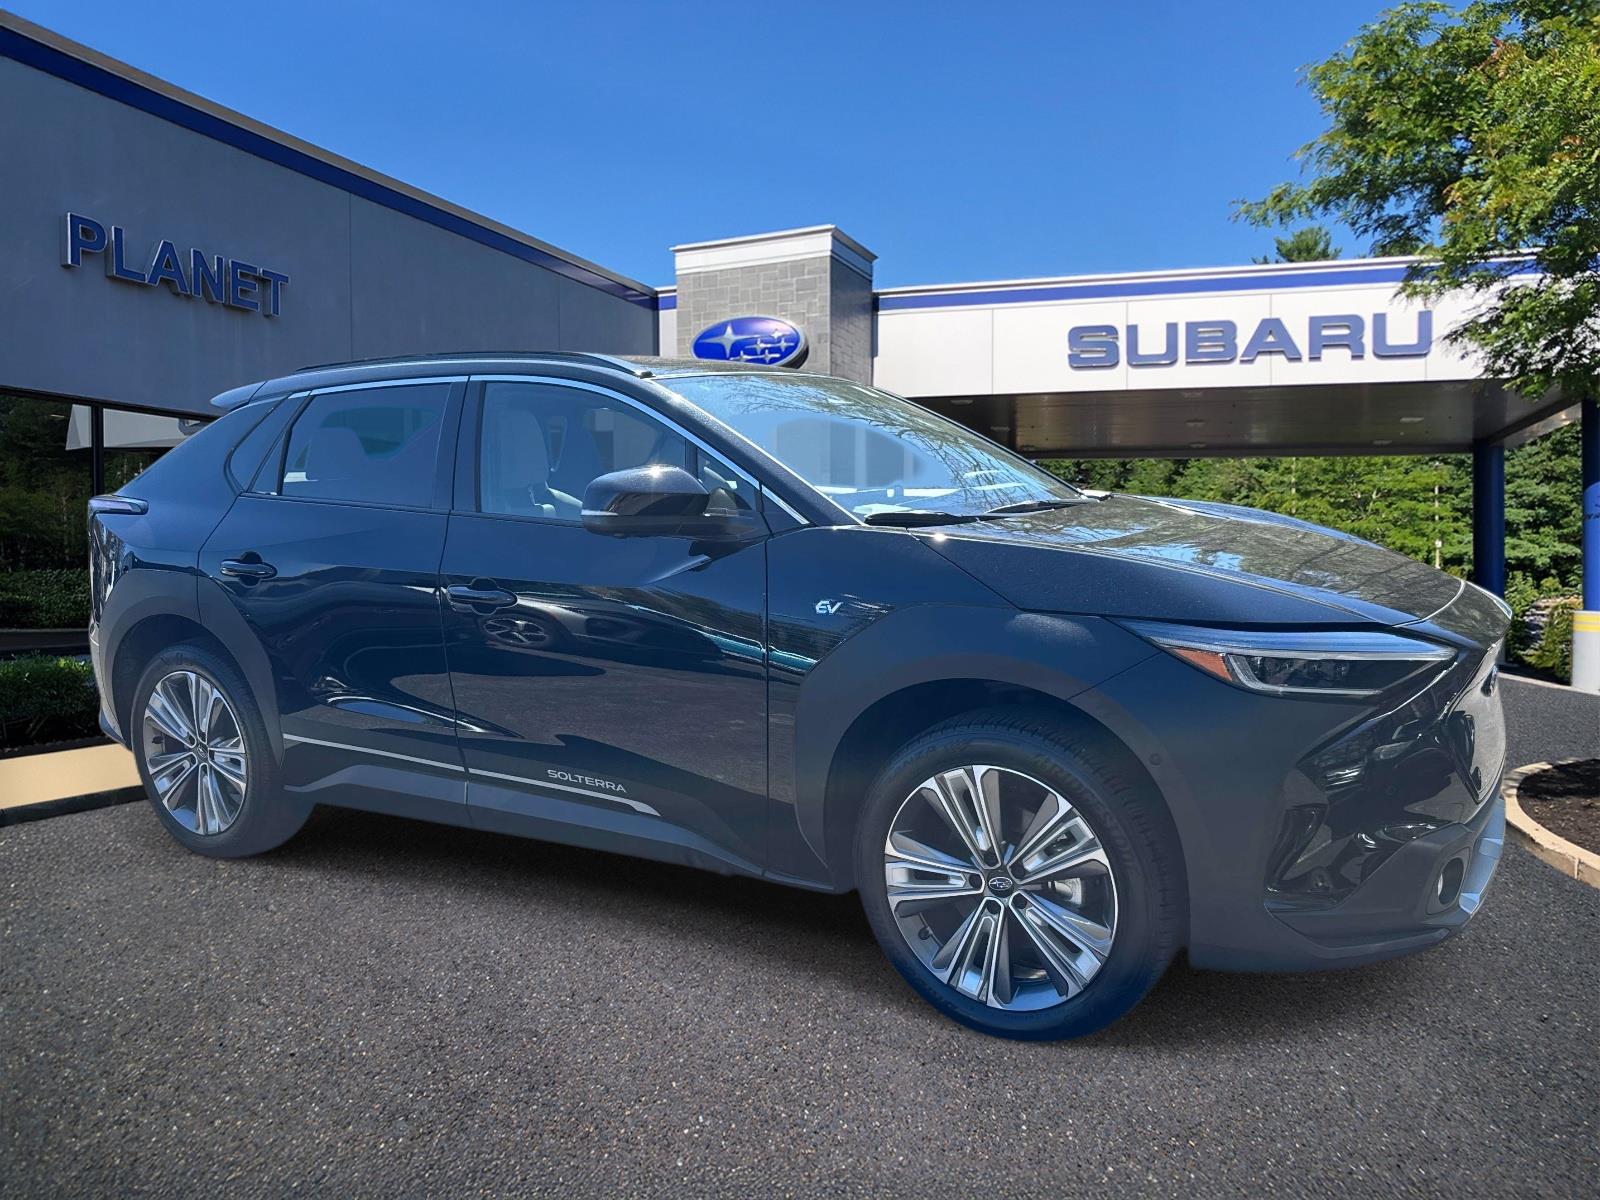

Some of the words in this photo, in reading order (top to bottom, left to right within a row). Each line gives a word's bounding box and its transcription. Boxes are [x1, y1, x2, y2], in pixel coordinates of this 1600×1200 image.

[63, 212, 290, 317] PLANET
[1067, 310, 1433, 370] SUBARU
[815, 599, 843, 614] EV
[547, 769, 627, 794] SOLTERRA
